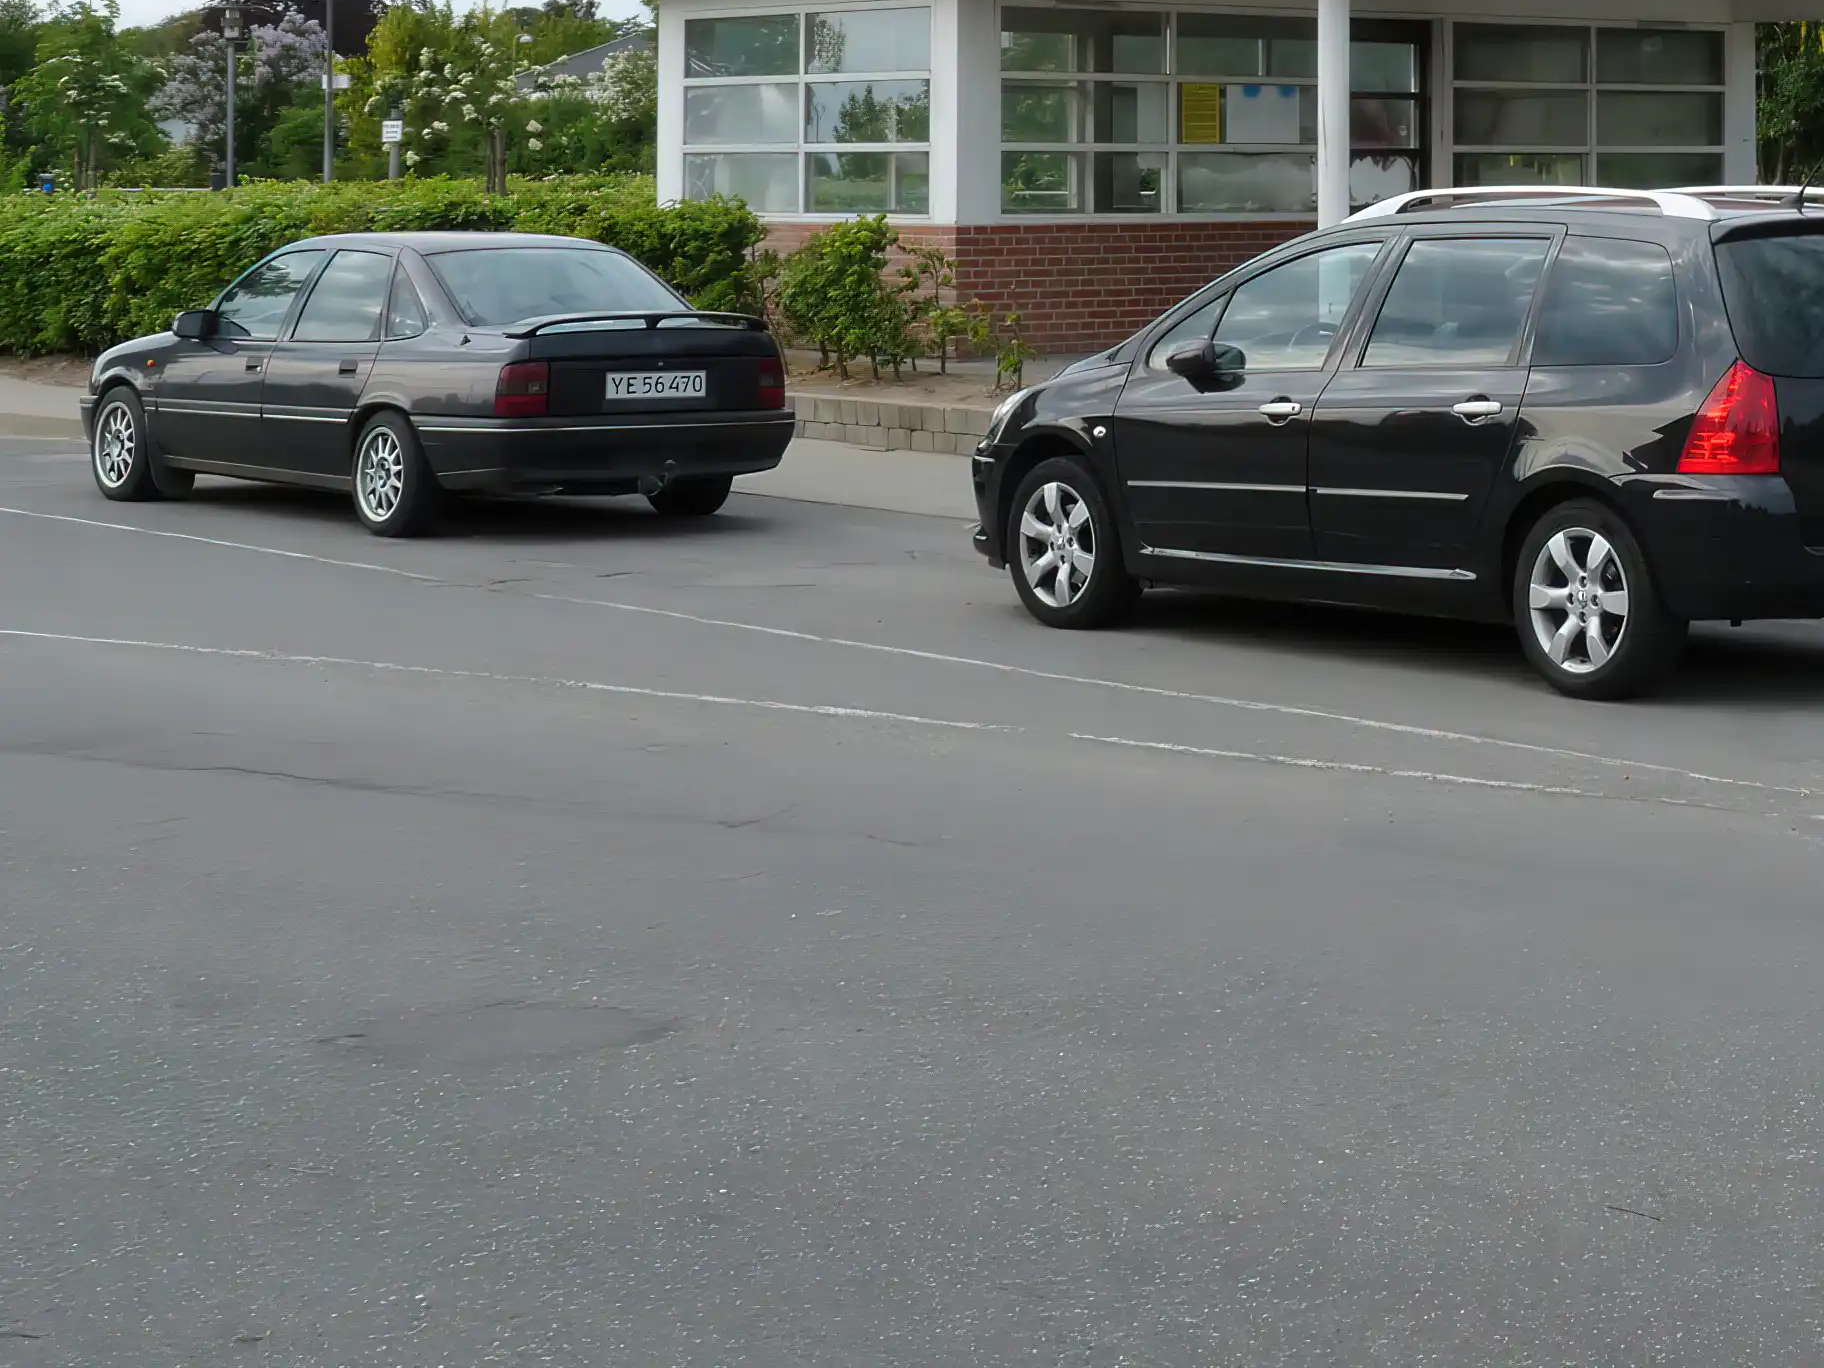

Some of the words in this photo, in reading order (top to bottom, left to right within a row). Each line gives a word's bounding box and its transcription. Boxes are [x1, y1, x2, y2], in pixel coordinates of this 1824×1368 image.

[612, 376, 637, 395] YE
[642, 376, 665, 394] 56
[669, 375, 703, 393] 470
